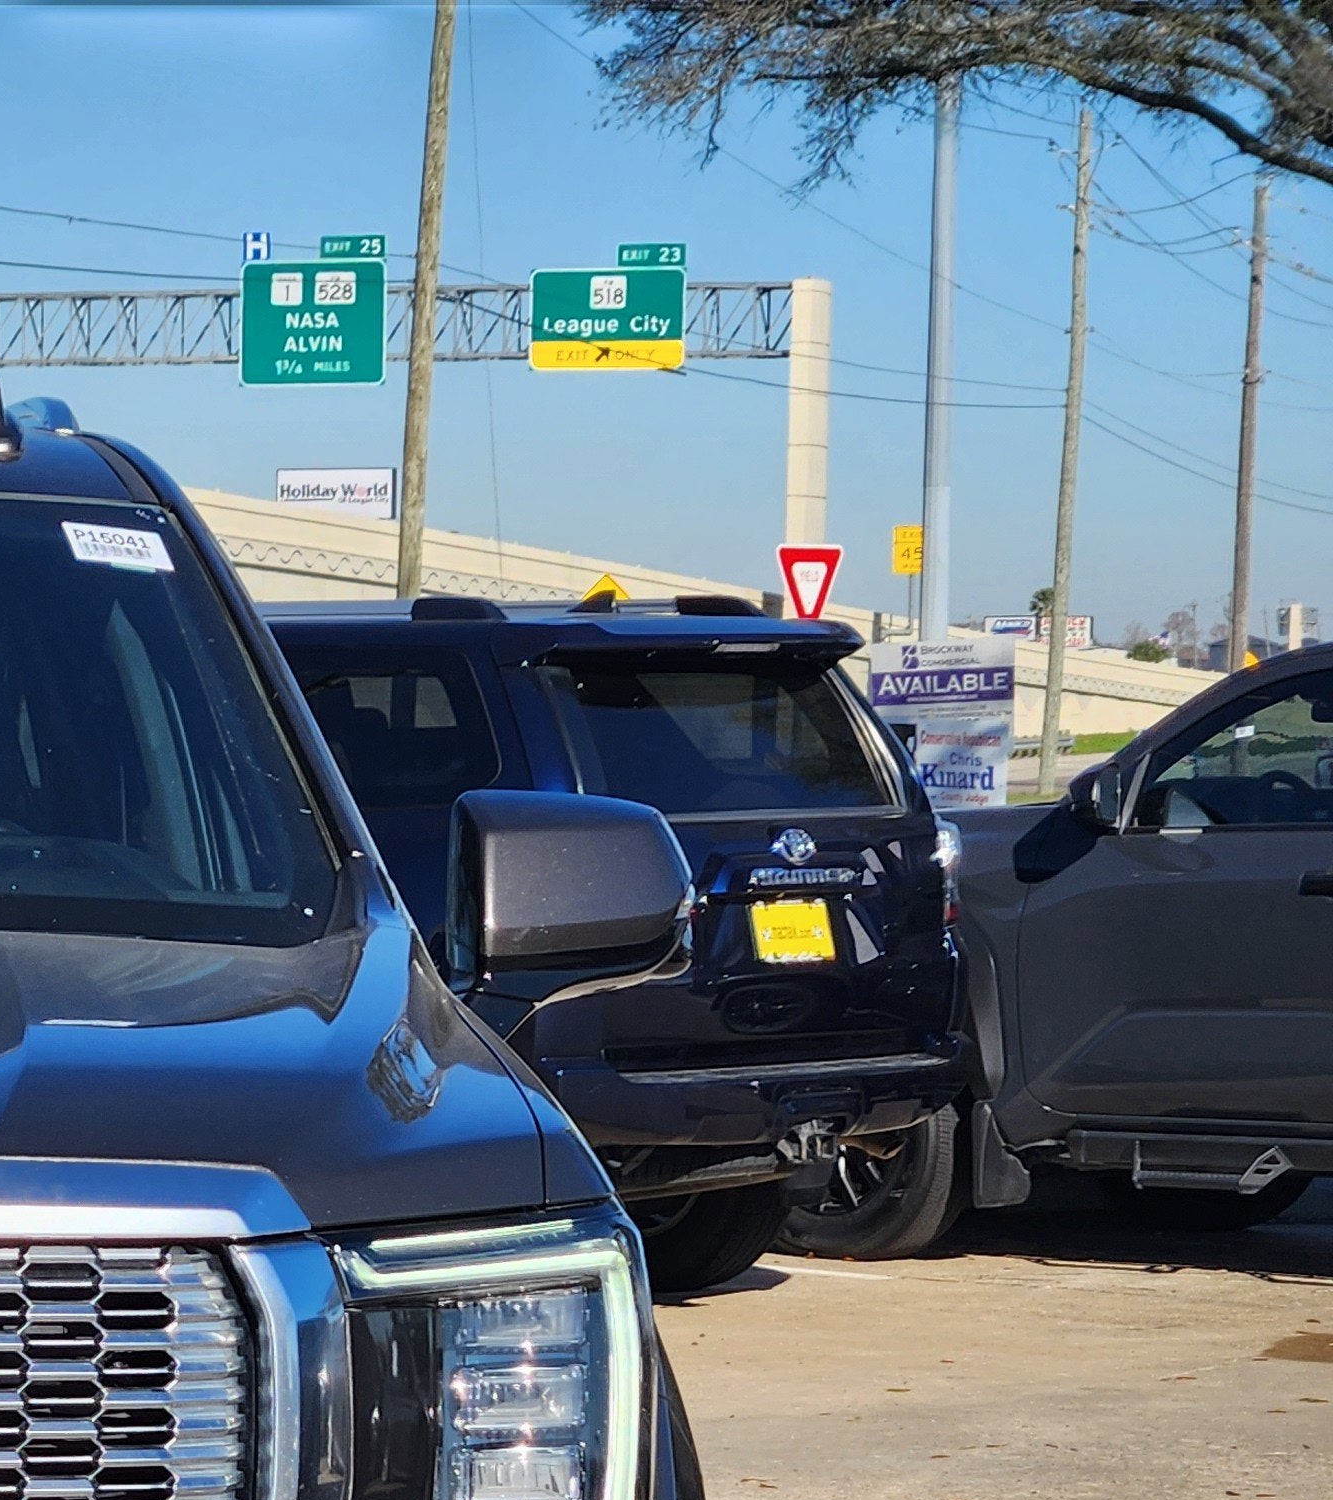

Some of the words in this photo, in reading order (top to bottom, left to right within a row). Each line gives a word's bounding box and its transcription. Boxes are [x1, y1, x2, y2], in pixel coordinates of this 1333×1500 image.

[246, 233, 268, 259] H
[324, 240, 351, 253] EXIT
[360, 238, 382, 254] 25
[622, 249, 650, 262] EXIT
[658, 247, 681, 263] 23
[285, 284, 290, 302] 1
[318, 283, 352, 301] 528
[594, 287, 624, 305] 518
[285, 312, 339, 329] NASA
[543, 317, 619, 338] League
[629, 315, 671, 337] City
[283, 335, 343, 353] ALVIN
[556, 350, 589, 361] EXIT
[313, 361, 350, 372] MILES
[280, 483, 337, 499] Holiday
[73, 529, 151, 549] P15041
[902, 546, 923, 560] 45
[921, 645, 974, 655] BROCKWAY
[921, 658, 982, 667] COMMERCIAL
[878, 671, 1009, 696] AVAILABLE
[949, 752, 983, 767] Chris
[921, 763, 995, 790] Kinard
